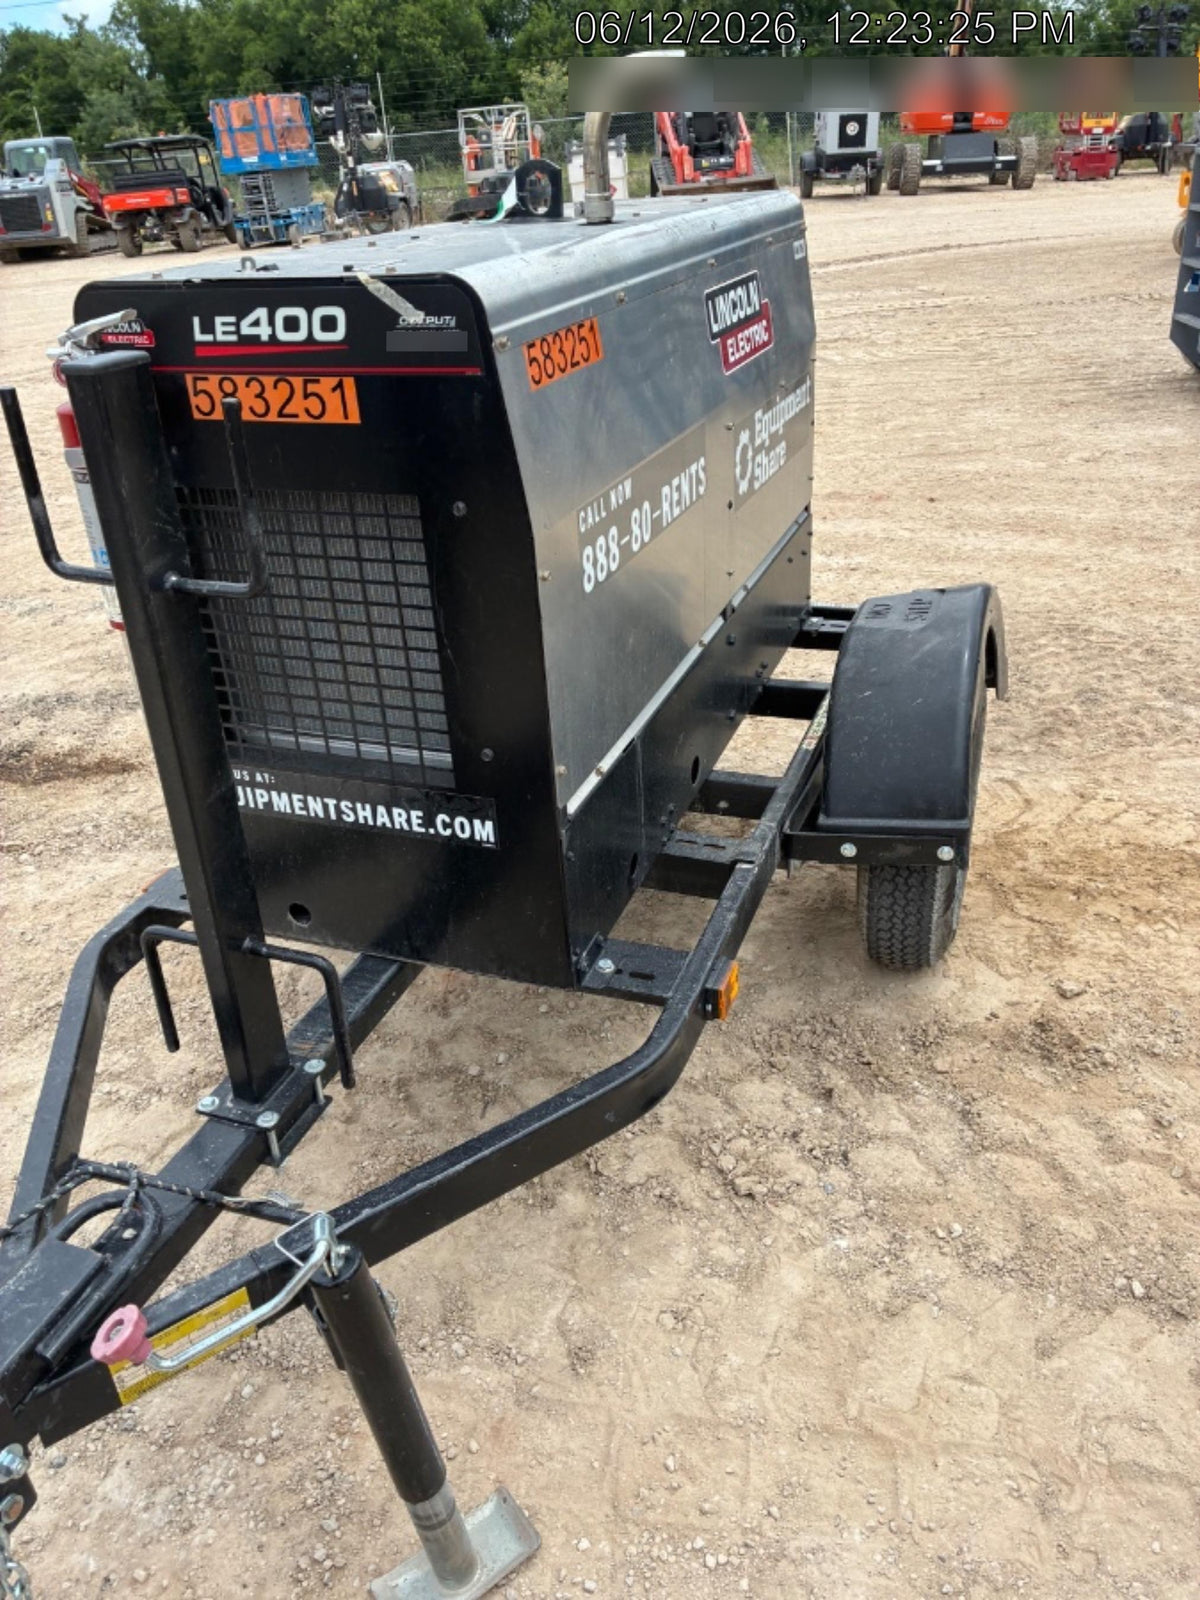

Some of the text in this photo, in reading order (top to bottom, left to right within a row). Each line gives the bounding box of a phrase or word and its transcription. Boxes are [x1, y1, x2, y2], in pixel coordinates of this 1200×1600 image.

[193, 306, 346, 342] LE400
[707, 279, 760, 333] LINCOLN
[527, 321, 600, 386] 583251
[726, 319, 769, 363] ELECTRIC
[754, 374, 811, 448] Equipment
[753, 440, 787, 491] Share
[579, 478, 632, 534] CALL NOW
[582, 456, 707, 594] 888-80-RENTS
[255, 771, 276, 784] AT:
